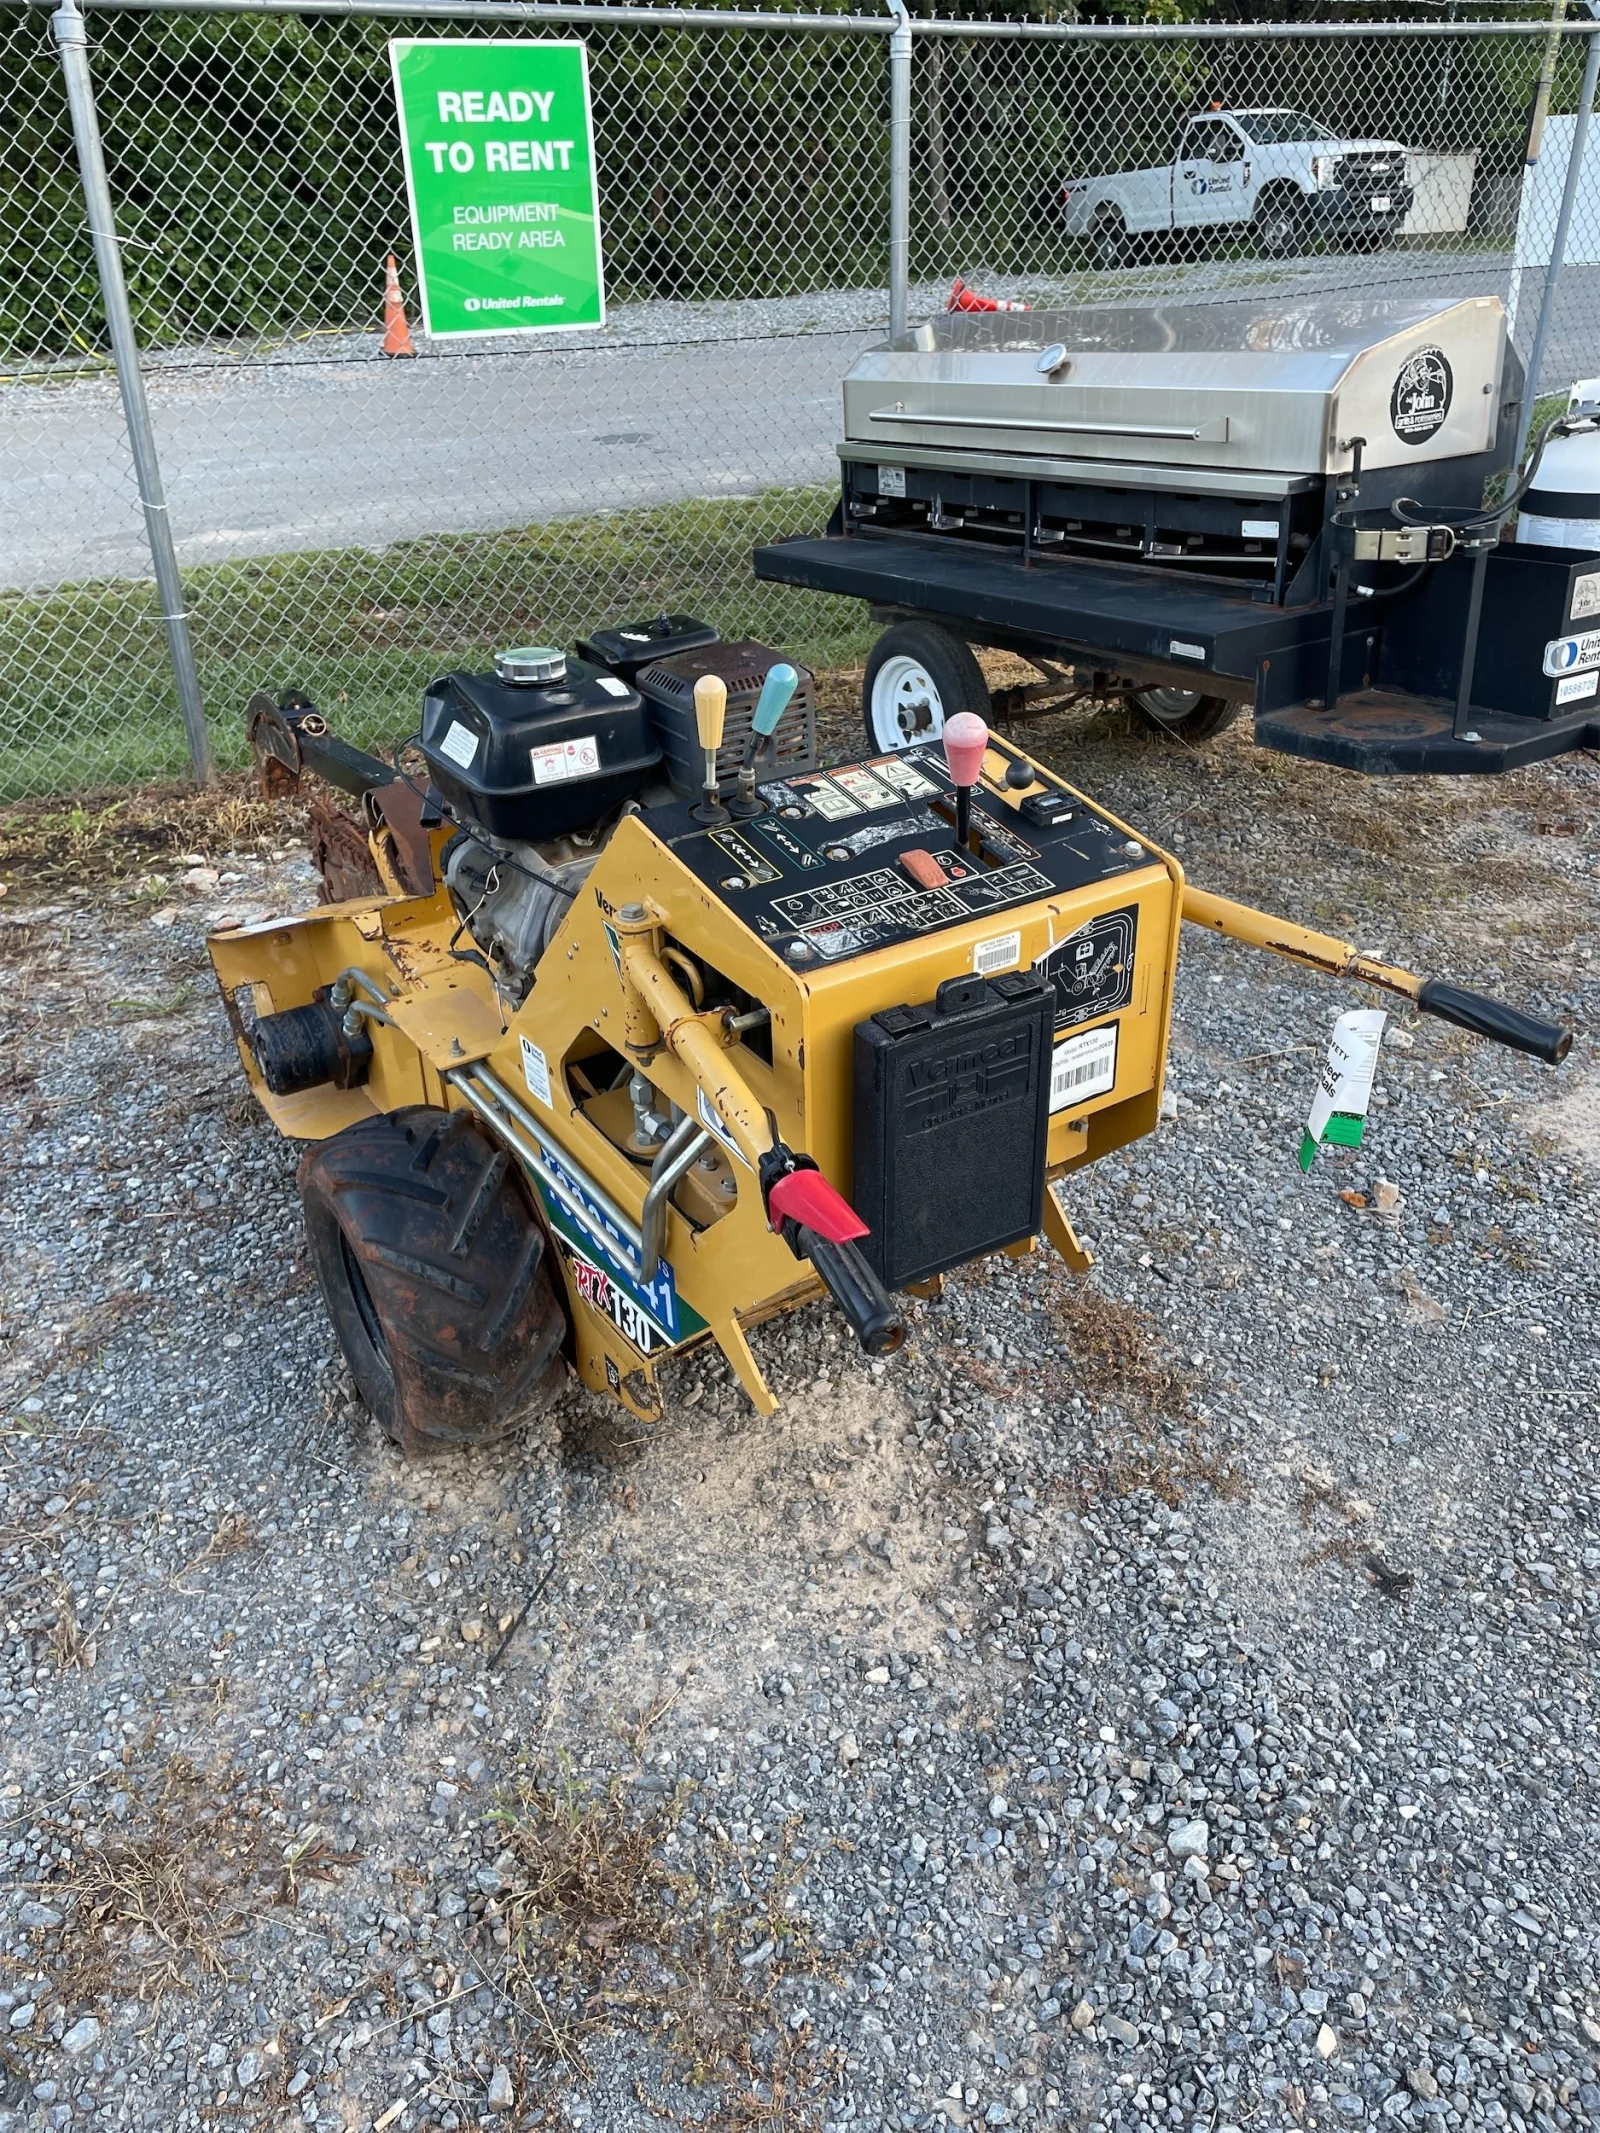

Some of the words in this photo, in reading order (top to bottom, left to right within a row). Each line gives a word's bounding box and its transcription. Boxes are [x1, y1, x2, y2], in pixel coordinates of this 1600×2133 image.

[437, 91, 555, 122] READY
[424, 141, 475, 173] TO
[485, 140, 574, 172] RENT
[453, 204, 559, 224] EQUIPMENT
[453, 232, 513, 251] READY
[518, 230, 566, 248] AREA
[482, 296, 521, 310] United
[522, 294, 564, 308] Rentals
[1409, 392, 1435, 414] John
[808, 921, 840, 935] STOP
[908, 1033, 1028, 1088] Vermeer
